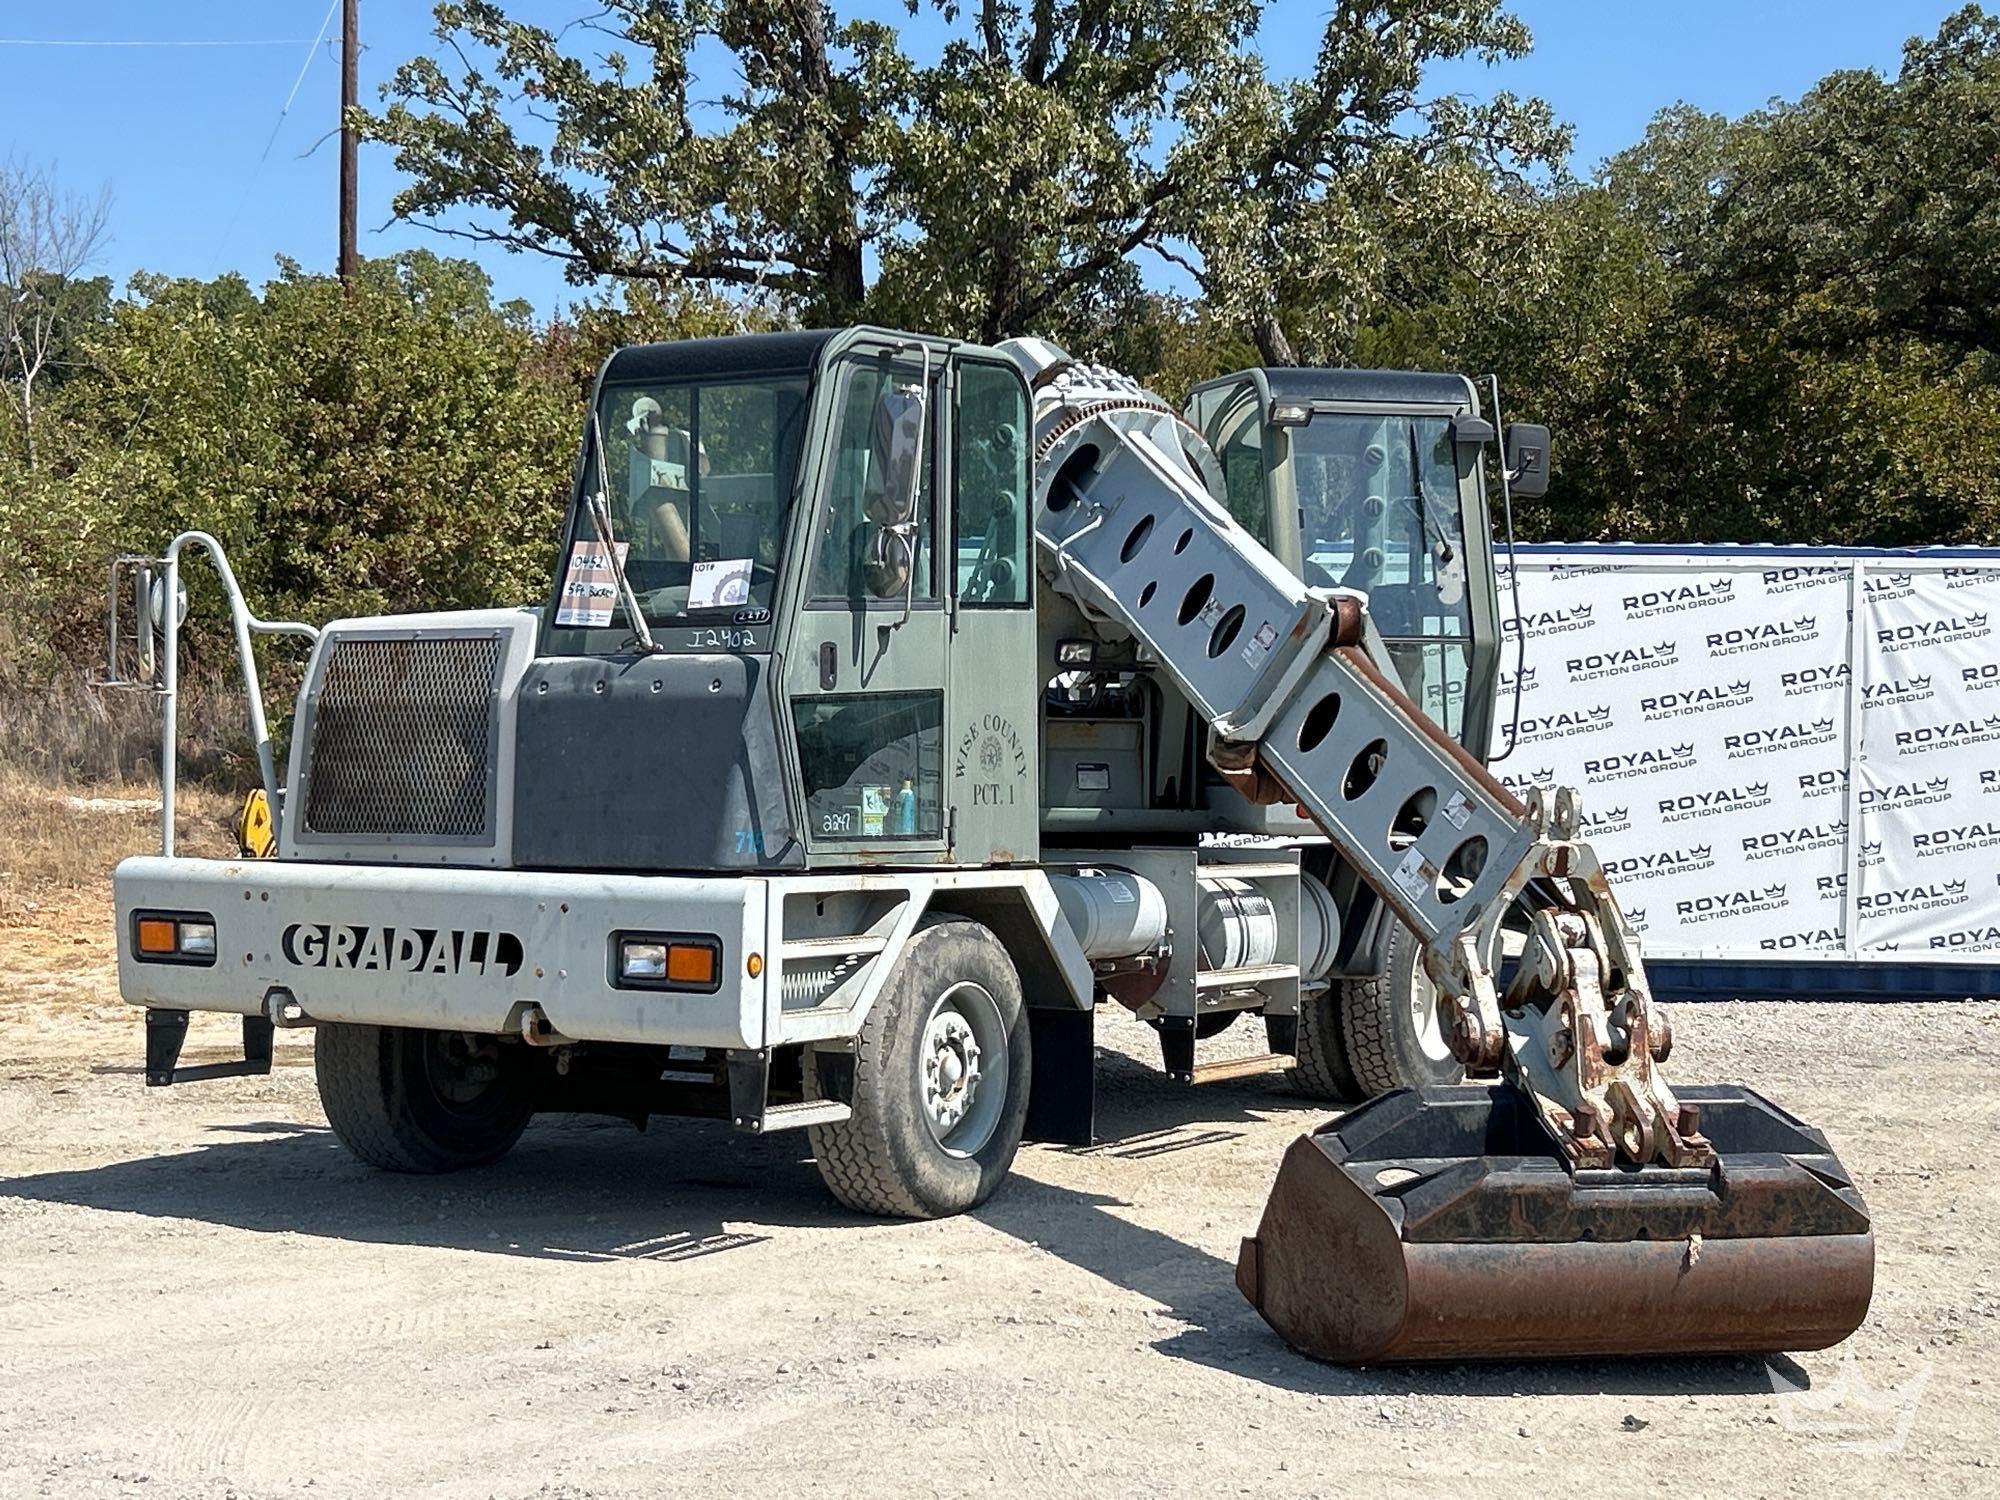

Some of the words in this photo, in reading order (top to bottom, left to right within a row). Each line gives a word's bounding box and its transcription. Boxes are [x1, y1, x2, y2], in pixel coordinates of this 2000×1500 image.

[1622, 584, 1710, 610] ROYAL
[1766, 578, 1826, 595] AUCTION
[1868, 588, 1916, 603] GROUP
[739, 609, 766, 620] 2247
[1626, 604, 1686, 620] AUCTION
[1688, 594, 1736, 608] GROUP
[1548, 620, 1596, 634] GROUP
[1706, 622, 1794, 648] ROYAL
[1877, 618, 1965, 643] ROYAL
[1709, 641, 1770, 658] AUCTION
[1772, 632, 1819, 646] GROUP
[1880, 637, 1941, 654] AUCTION
[1943, 628, 1992, 643] GROUP
[1566, 647, 1654, 673] ROYAL
[1569, 666, 1630, 683] AUCTION
[1632, 657, 1679, 672] GROUP
[1641, 686, 1728, 712] ROYAL
[1784, 680, 1844, 697] AUCTION
[1886, 691, 1935, 705] GROUP
[1644, 705, 1704, 722] AUCTION
[1706, 696, 1754, 711] GROUP
[1501, 711, 1588, 737] ROYAL
[1504, 730, 1564, 747] AUCTION
[1566, 721, 1614, 736] GROUP
[1724, 723, 1812, 749] ROYAL
[1895, 720, 1984, 745] ROYAL
[955, 722, 980, 778] WISE
[983, 714, 1027, 778] COUNTY
[1727, 742, 1787, 760] AUCTION
[1790, 733, 1837, 748] GROUP
[1898, 739, 1959, 756] AUCTION
[1584, 749, 1671, 774] ROYAL
[1587, 767, 1647, 784] AUCTION
[1650, 758, 1697, 773] GROUP
[973, 783, 1003, 805] PCT.
[1009, 784, 1015, 805] 1
[1658, 788, 1746, 814] ROYAL
[1904, 793, 1952, 808] GROUP
[822, 812, 851, 831] 2247
[1661, 806, 1722, 824] AUCTION
[1724, 797, 1772, 812] GROUP
[1234, 836, 1275, 847] GROU
[1584, 822, 1632, 838] GROUP
[1742, 825, 1829, 851] ROYAL
[1913, 822, 2000, 848] ROYAL
[1745, 844, 1805, 861] AUCTION
[1808, 835, 1848, 850] GROU
[1916, 841, 1976, 858] AUCTION
[1602, 849, 1690, 875] ROYAL
[1606, 868, 1665, 885] AUCTION
[1668, 860, 1715, 875] GROUP
[1676, 889, 1764, 915] ROYAL
[1857, 884, 1944, 910] ROYAL
[1859, 904, 1919, 920] AUCTION
[1921, 895, 1969, 910] GROUP
[1679, 908, 1740, 924] AUCTION
[1742, 900, 1790, 914] GROUP
[292, 923, 511, 977] GRADALL
[1760, 927, 1846, 950] ROYAL
